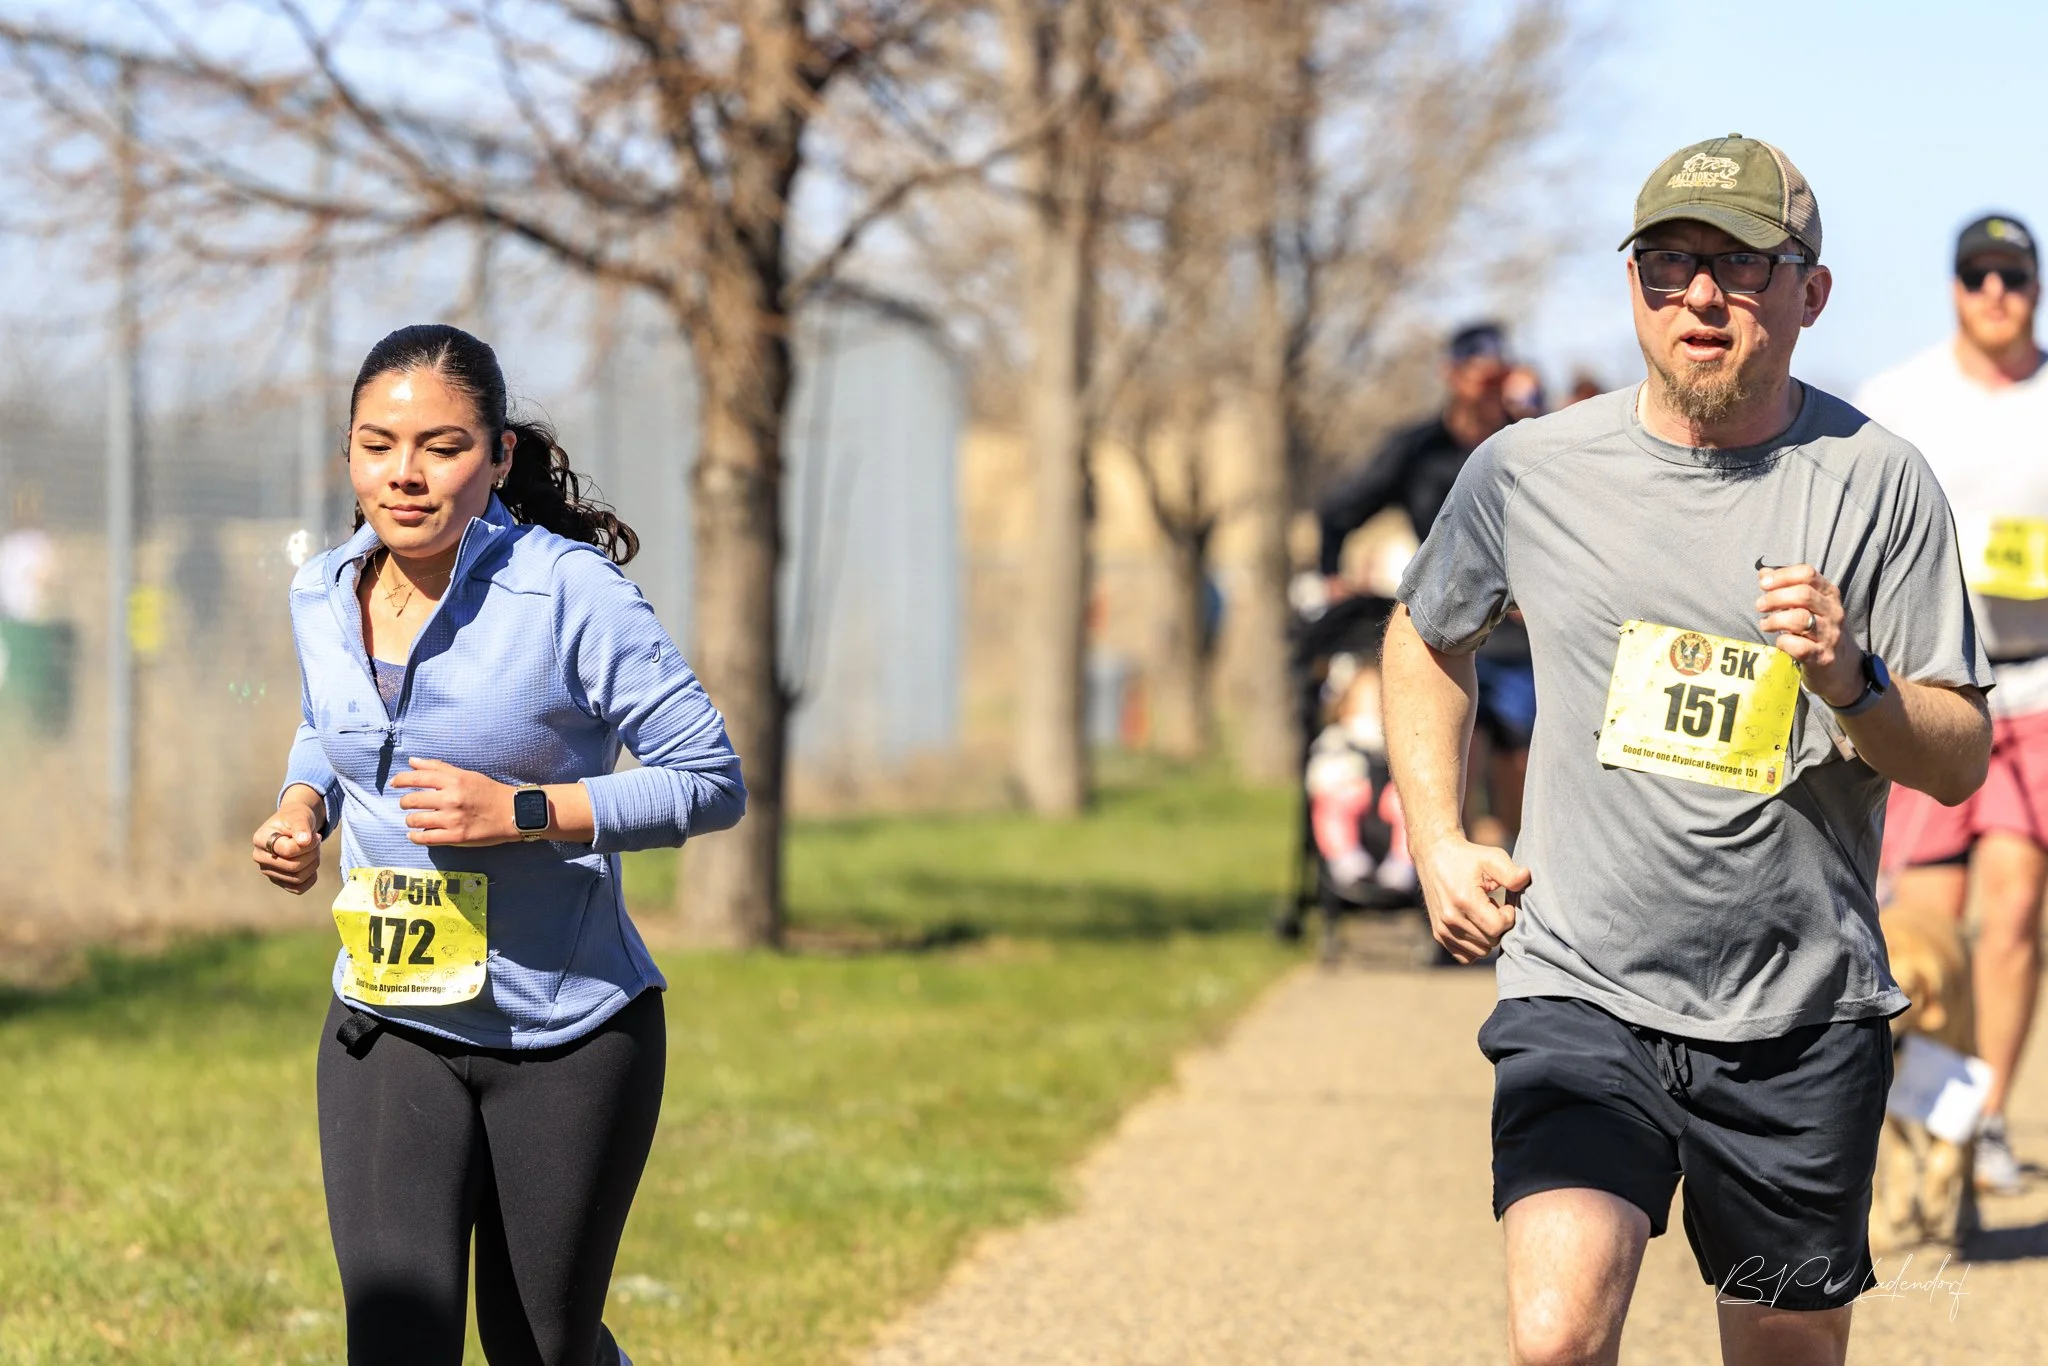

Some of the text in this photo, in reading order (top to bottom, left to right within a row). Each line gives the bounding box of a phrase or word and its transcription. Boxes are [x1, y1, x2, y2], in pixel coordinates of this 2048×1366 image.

[1720, 647, 1760, 680] 5K
[1664, 682, 1740, 743] 151
[1622, 744, 1758, 778] Good for one Atypical Beverage 151
[407, 877, 442, 906] 5K
[368, 915, 435, 965] 472
[379, 984, 409, 992] Atypical
[411, 984, 446, 994] Beverage
